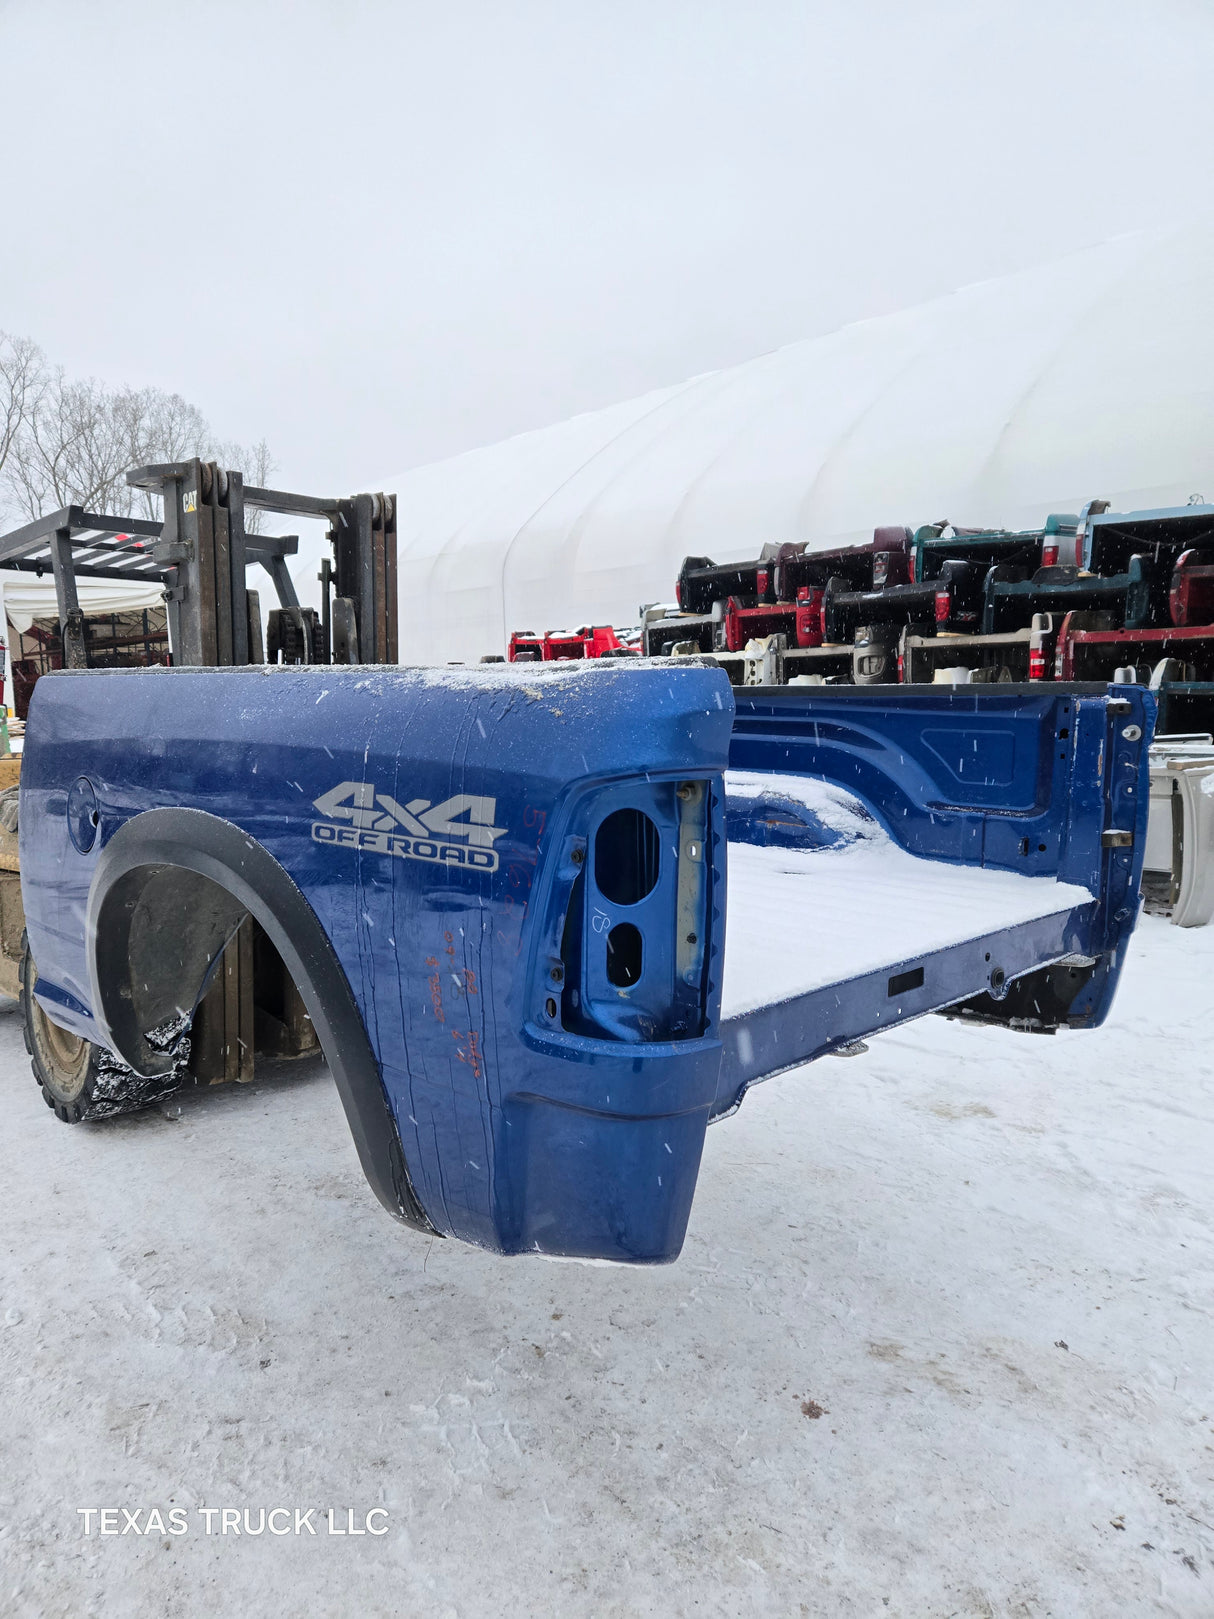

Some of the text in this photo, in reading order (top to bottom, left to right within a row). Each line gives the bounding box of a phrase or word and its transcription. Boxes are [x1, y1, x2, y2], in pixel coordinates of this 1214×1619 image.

[183, 490, 197, 513] CAT
[314, 825, 495, 868] OFF ROAD
